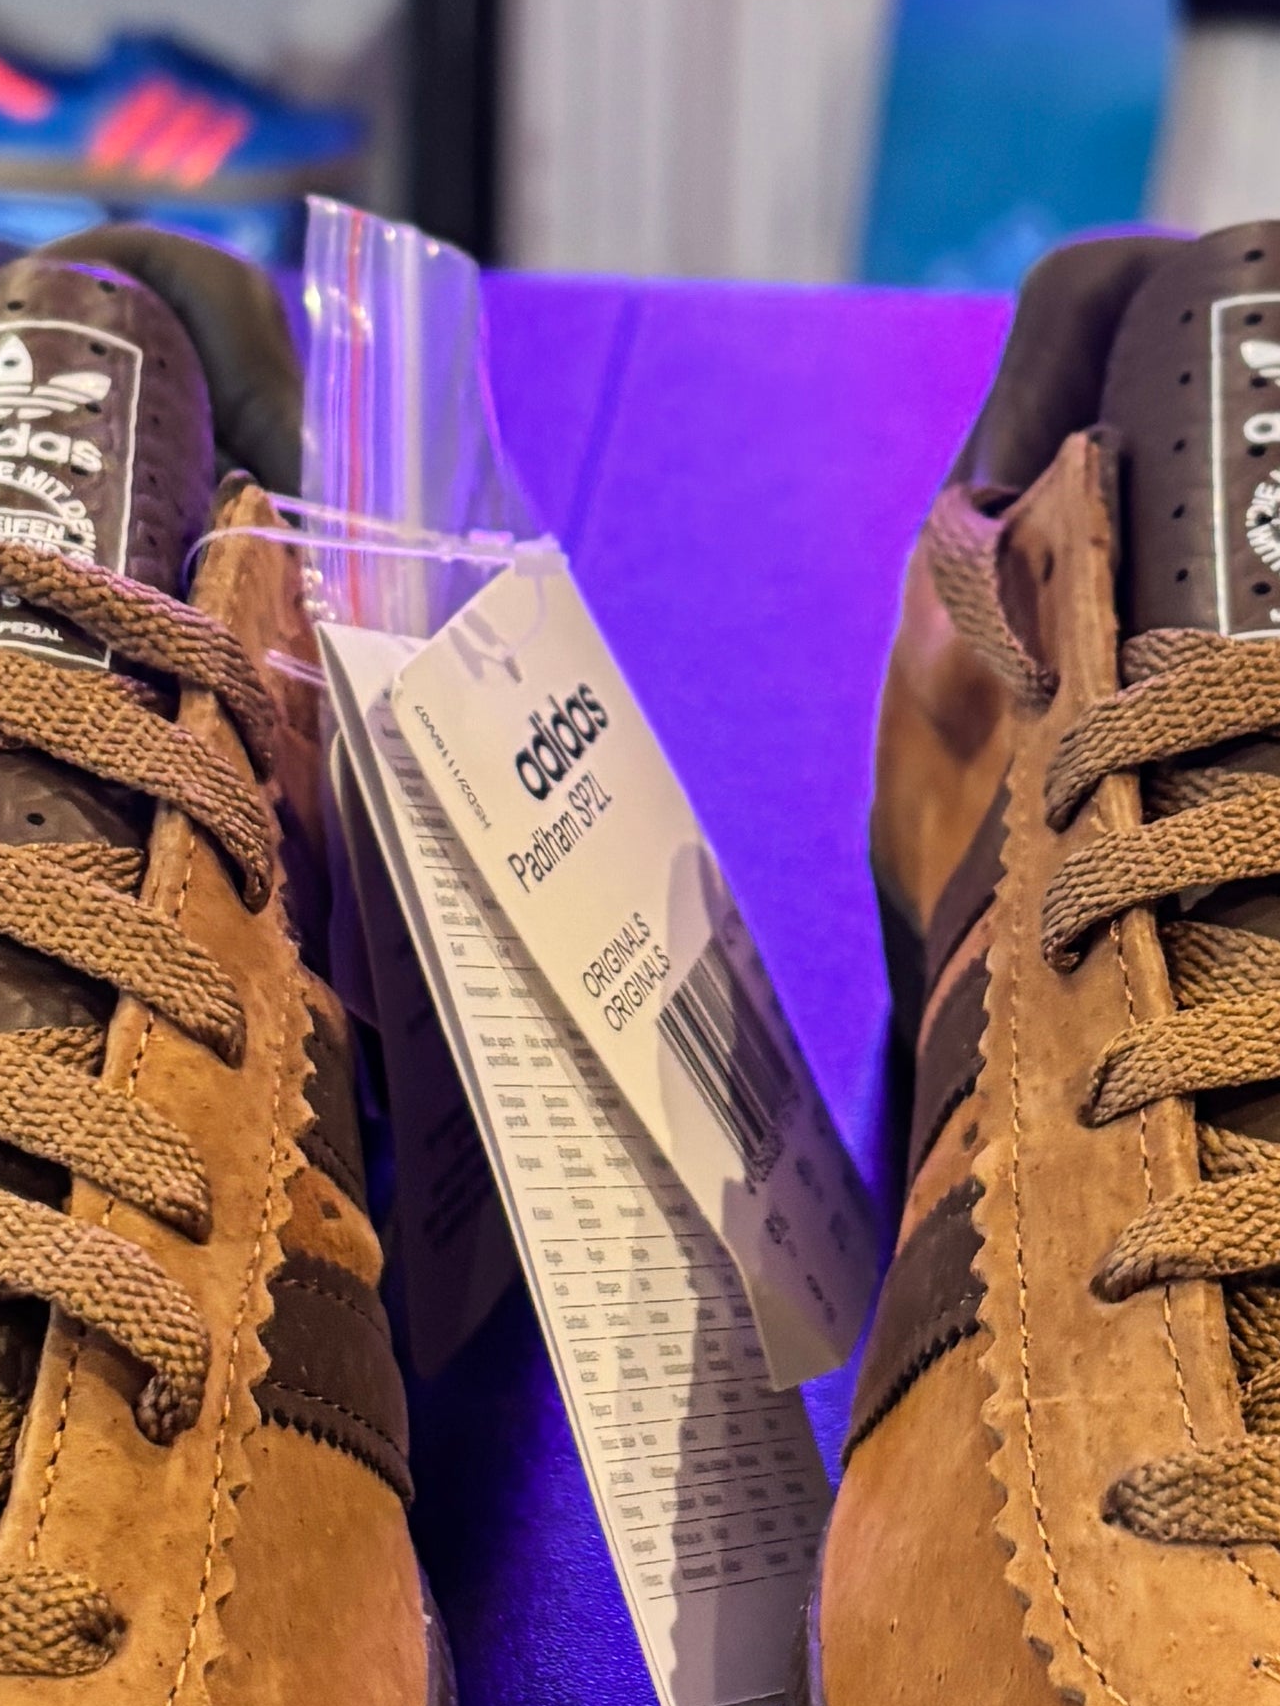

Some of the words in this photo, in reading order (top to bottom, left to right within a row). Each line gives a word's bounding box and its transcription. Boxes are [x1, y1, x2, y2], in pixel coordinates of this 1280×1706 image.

[19, 465, 72, 500] MIT
[515, 681, 610, 802] adidas
[507, 810, 584, 894] Padiham
[567, 769, 613, 828] SPZL
[582, 912, 651, 998] ORIGINALS
[603, 944, 671, 1032] ORIGINALS
